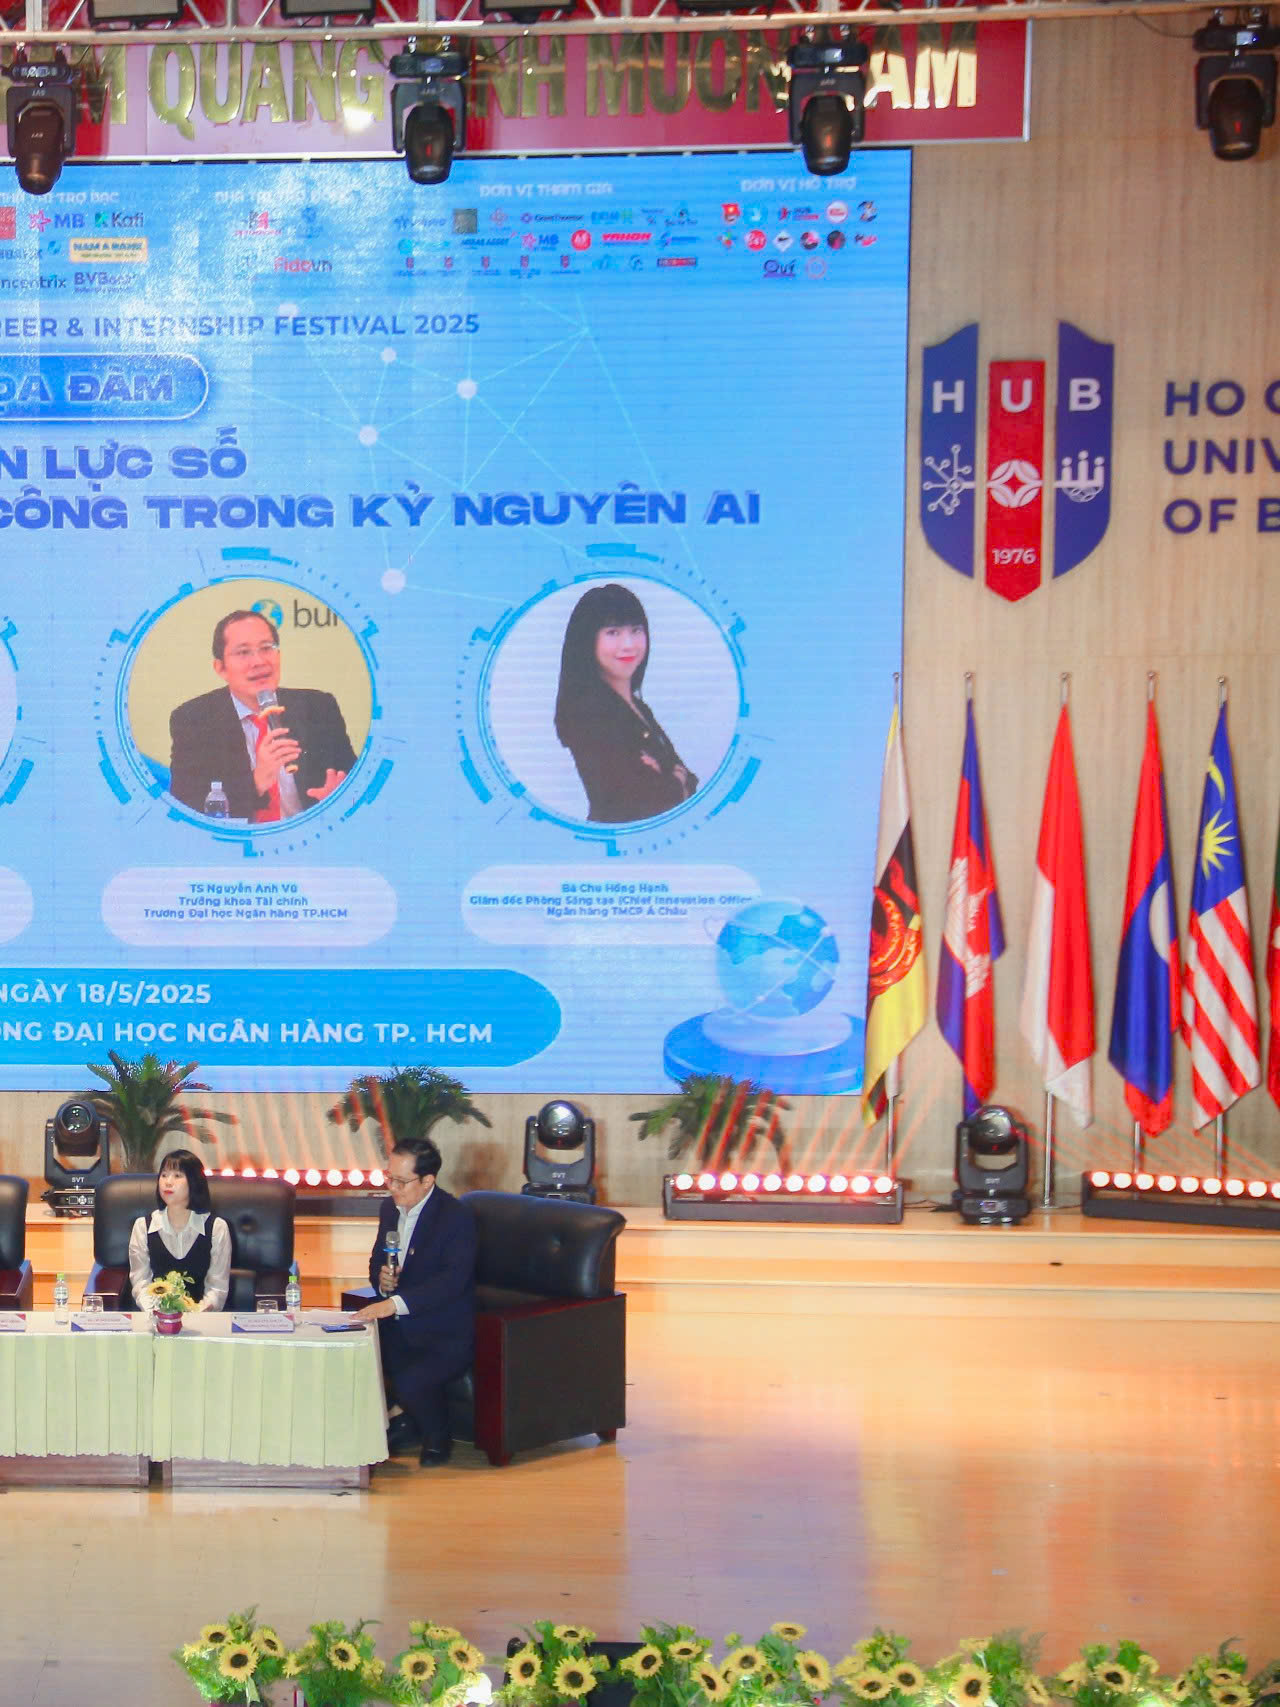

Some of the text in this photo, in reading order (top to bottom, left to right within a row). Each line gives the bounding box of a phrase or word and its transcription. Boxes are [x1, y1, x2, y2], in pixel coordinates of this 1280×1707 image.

[148, 38, 385, 140] QUANG
[54, 213, 85, 228] MB
[66, 317, 84, 337] &
[95, 316, 264, 337] INTERNSHIP
[274, 315, 406, 336] FESTIVAL
[414, 313, 480, 334] 2025
[1165, 380, 1246, 417] HO
[43, 441, 153, 492] LỰC
[168, 426, 248, 479] SỐ
[144, 494, 336, 529] TRONG
[451, 481, 687, 527] NGUYÊN
[704, 490, 761, 525] AI
[1163, 498, 1239, 535] OF
[992, 548, 1037, 565] 1976
[190, 884, 205, 893] TS
[255, 884, 278, 893] Anh
[224, 896, 253, 906] khoa
[302, 908, 348, 918] TP.HCM
[80, 980, 211, 1006] 18/5/2025
[52, 1022, 104, 1047] ĐẠI
[114, 1022, 177, 1047] HỌC
[187, 1018, 269, 1043] NGÂN
[280, 1018, 364, 1043] HÀNG
[374, 1022, 416, 1044] TP.
[427, 1022, 493, 1043] HCM
